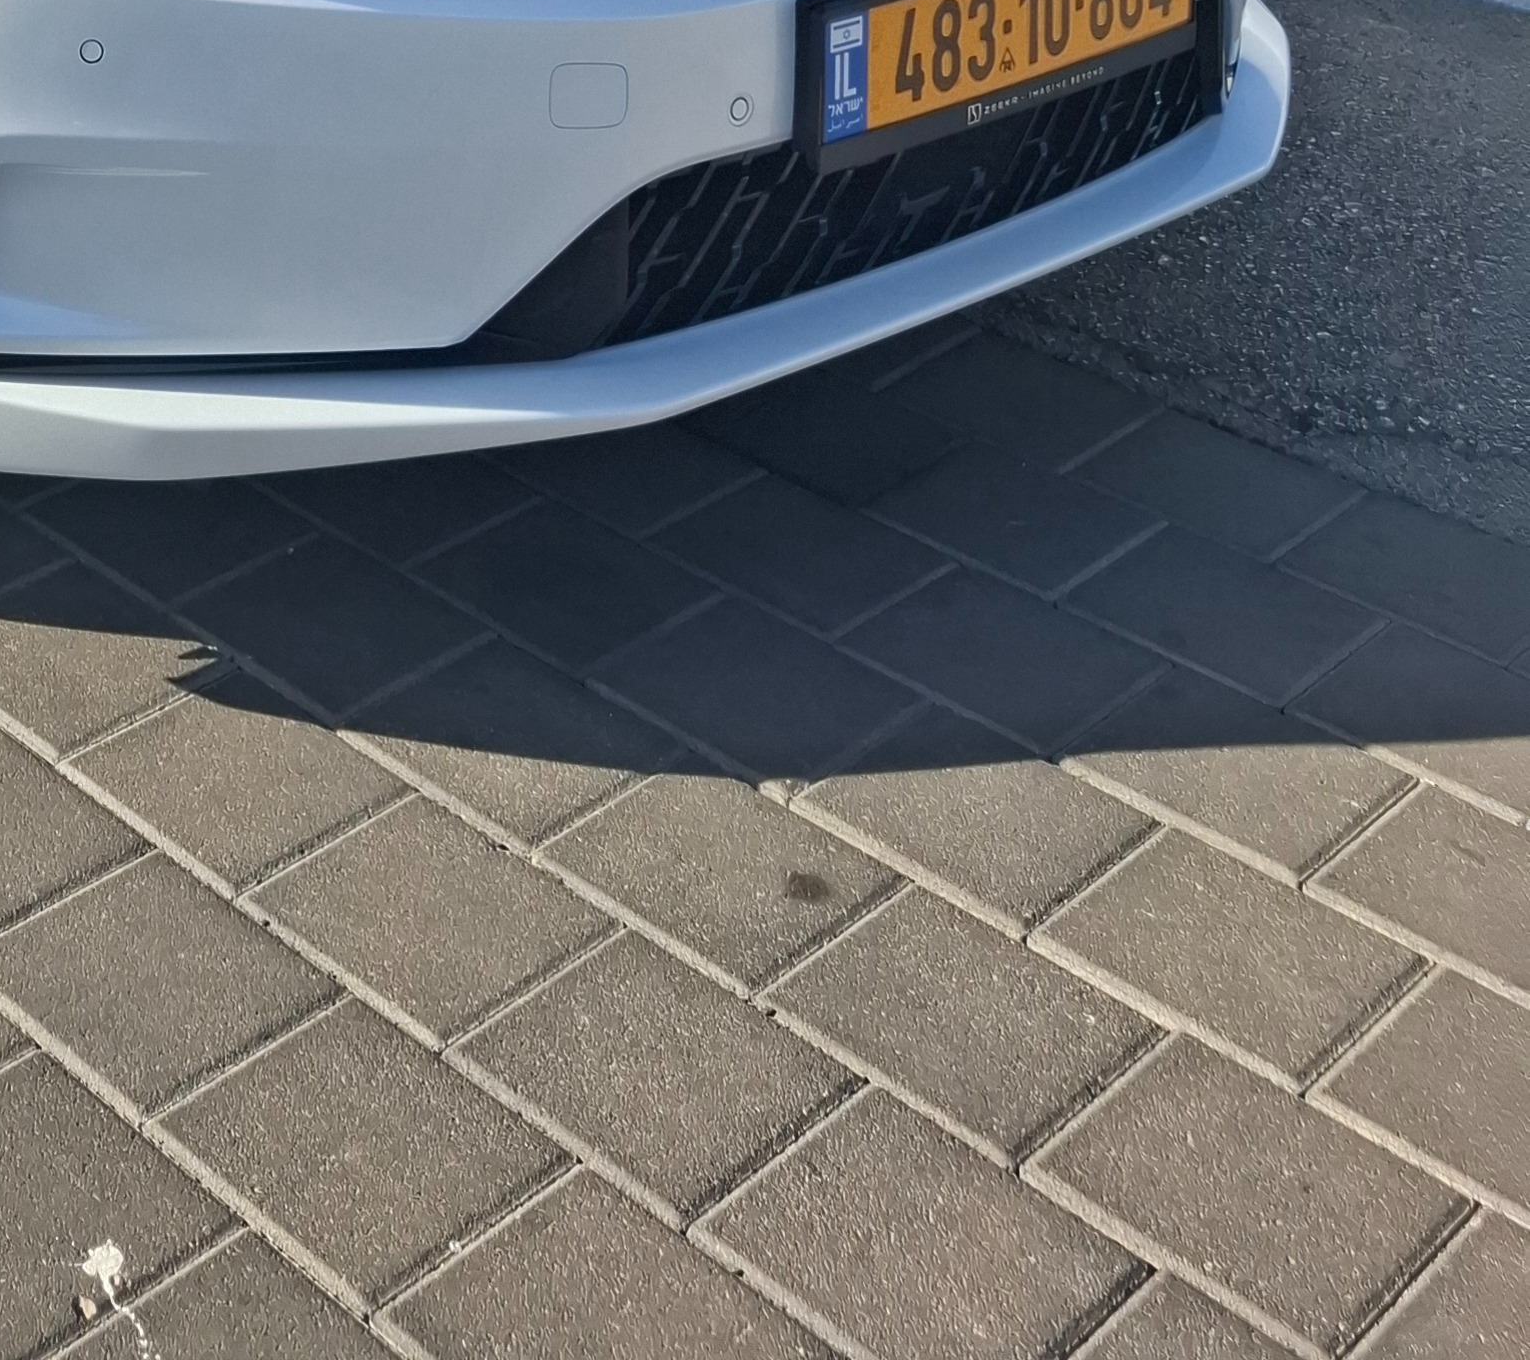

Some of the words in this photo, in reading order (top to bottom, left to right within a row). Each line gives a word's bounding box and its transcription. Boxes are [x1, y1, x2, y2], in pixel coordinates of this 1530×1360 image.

[834, 51, 857, 100] IL
[983, 95, 1019, 115] ZEEKR
[1028, 79, 1067, 99] IMAGINE
[1070, 66, 1104, 86] BEYOND
[827, 96, 864, 118] ישראל
